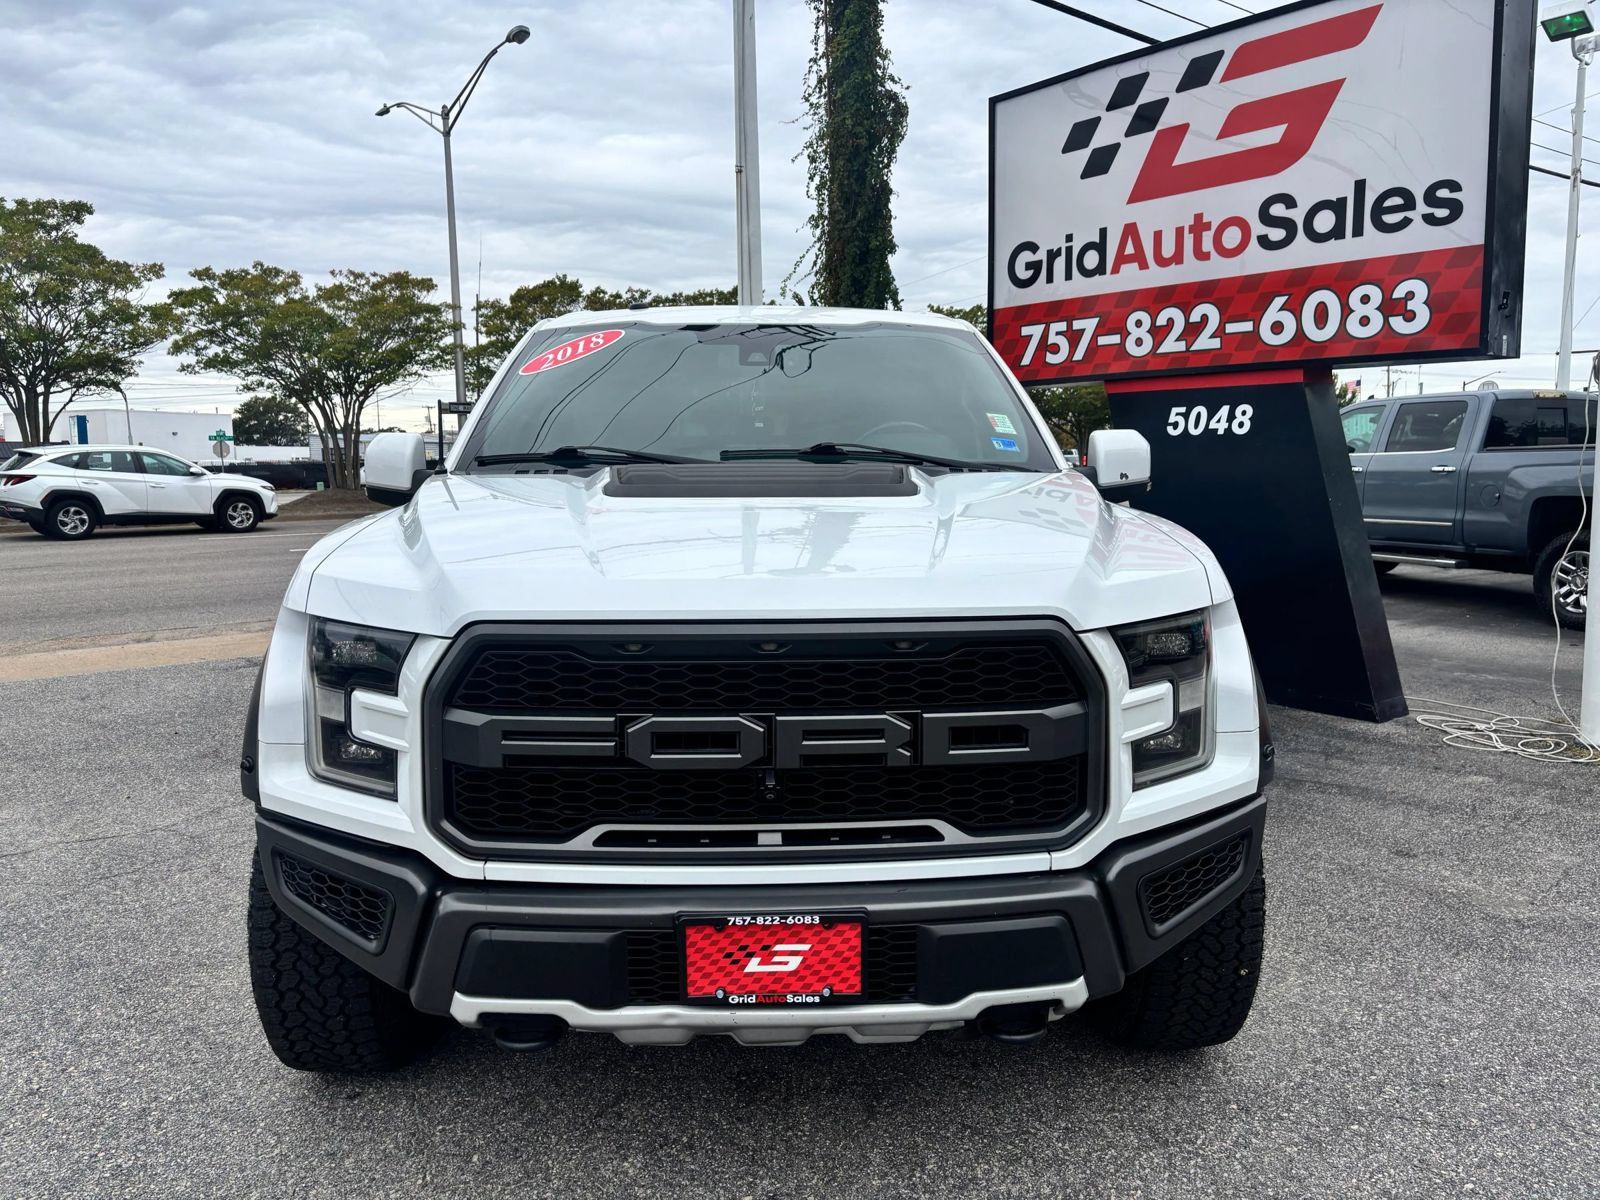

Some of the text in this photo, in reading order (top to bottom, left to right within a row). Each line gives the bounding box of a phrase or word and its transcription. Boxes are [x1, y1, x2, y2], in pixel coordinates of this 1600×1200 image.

[1007, 178, 1465, 290] GridAutoSales
[1019, 277, 1432, 368] 757-822-6083
[540, 333, 604, 369] 2018
[1166, 404, 1254, 437] 5048
[442, 707, 1088, 769] FORD
[727, 915, 820, 926] 757-822-6083
[728, 994, 821, 1005] GridAutoSales
